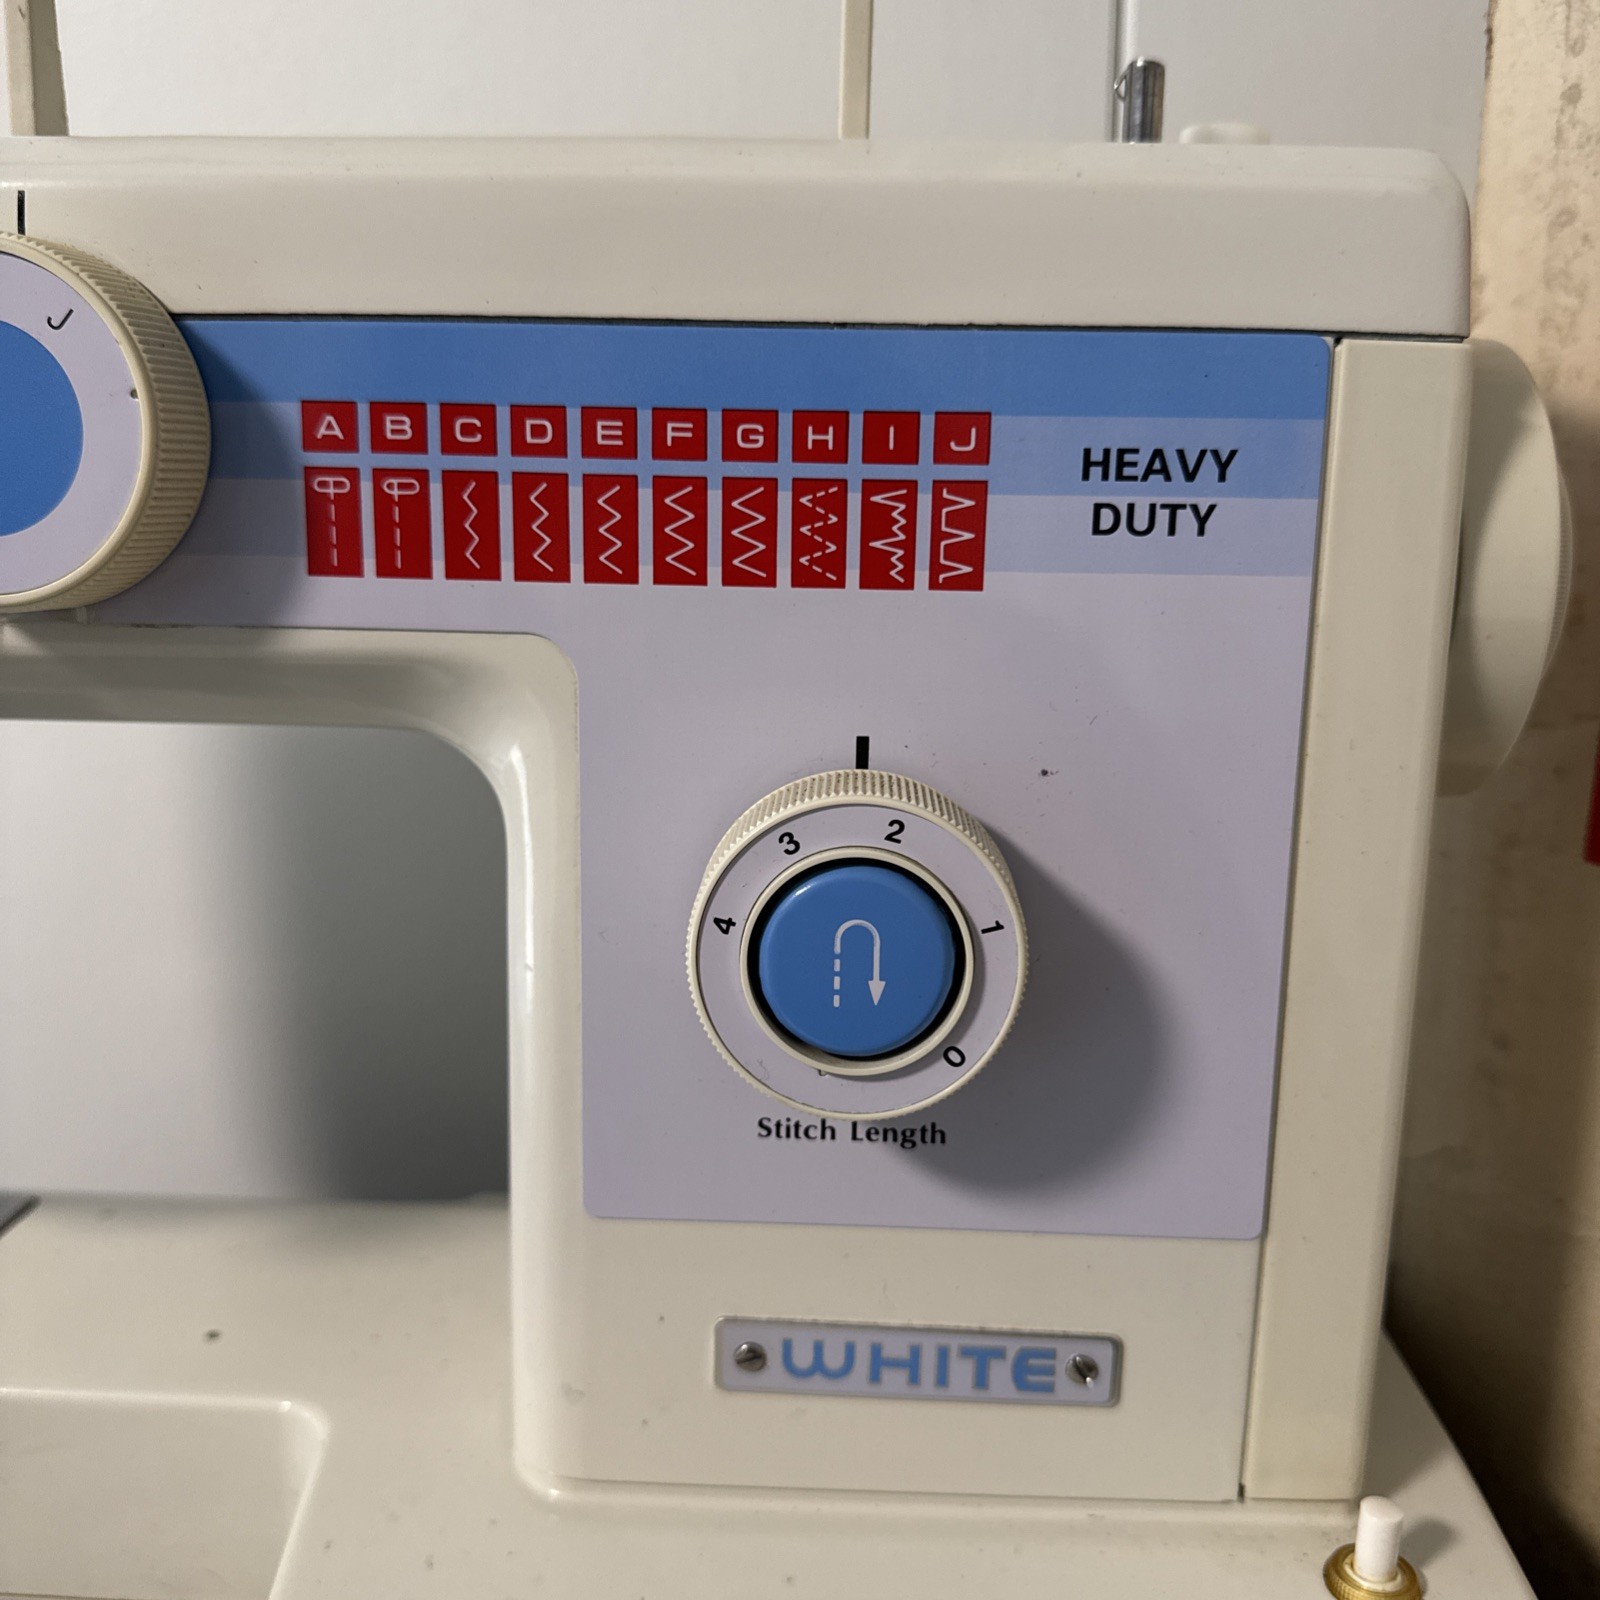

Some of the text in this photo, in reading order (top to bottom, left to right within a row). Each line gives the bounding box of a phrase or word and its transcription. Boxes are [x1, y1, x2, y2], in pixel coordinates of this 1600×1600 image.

[47, 308, 74, 330] J
[316, 414, 977, 452] A B C D E F G H I J
[1081, 447, 1238, 483] HEAVY
[1091, 502, 1217, 537] DUTY
[778, 831, 801, 856] 3
[884, 819, 906, 844] 2
[712, 915, 737, 936] 4
[980, 919, 1005, 935] 1
[942, 1045, 967, 1068] 0
[757, 1117, 948, 1149] Stitch Length
[781, 1337, 1058, 1394] WHITE
